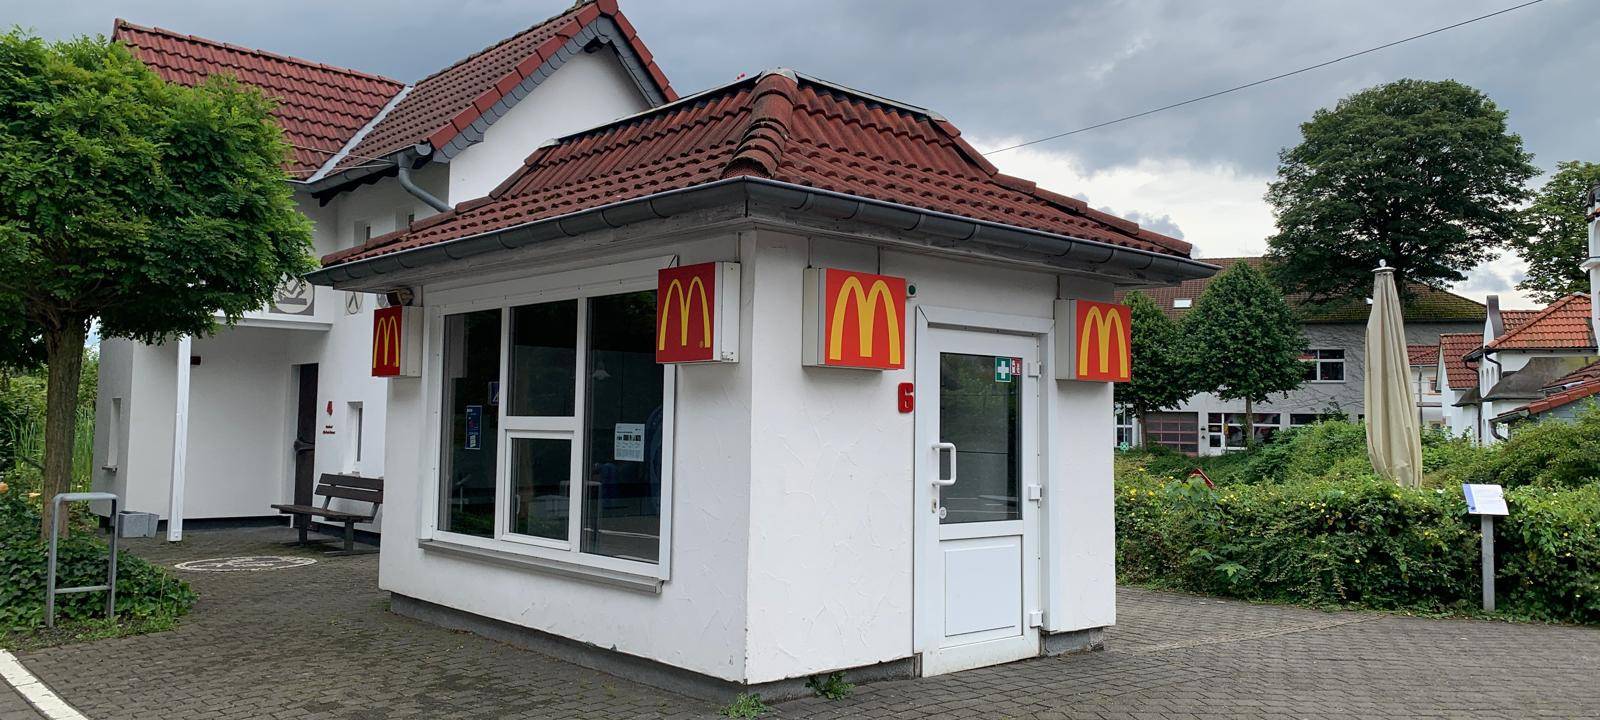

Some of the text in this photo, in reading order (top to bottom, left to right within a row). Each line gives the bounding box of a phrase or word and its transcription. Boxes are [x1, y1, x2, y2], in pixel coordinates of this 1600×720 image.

[373, 316, 399, 368] M
[659, 276, 711, 351] M
[829, 276, 900, 365] M
[1080, 306, 1128, 378] M
[898, 383, 914, 413] 6
